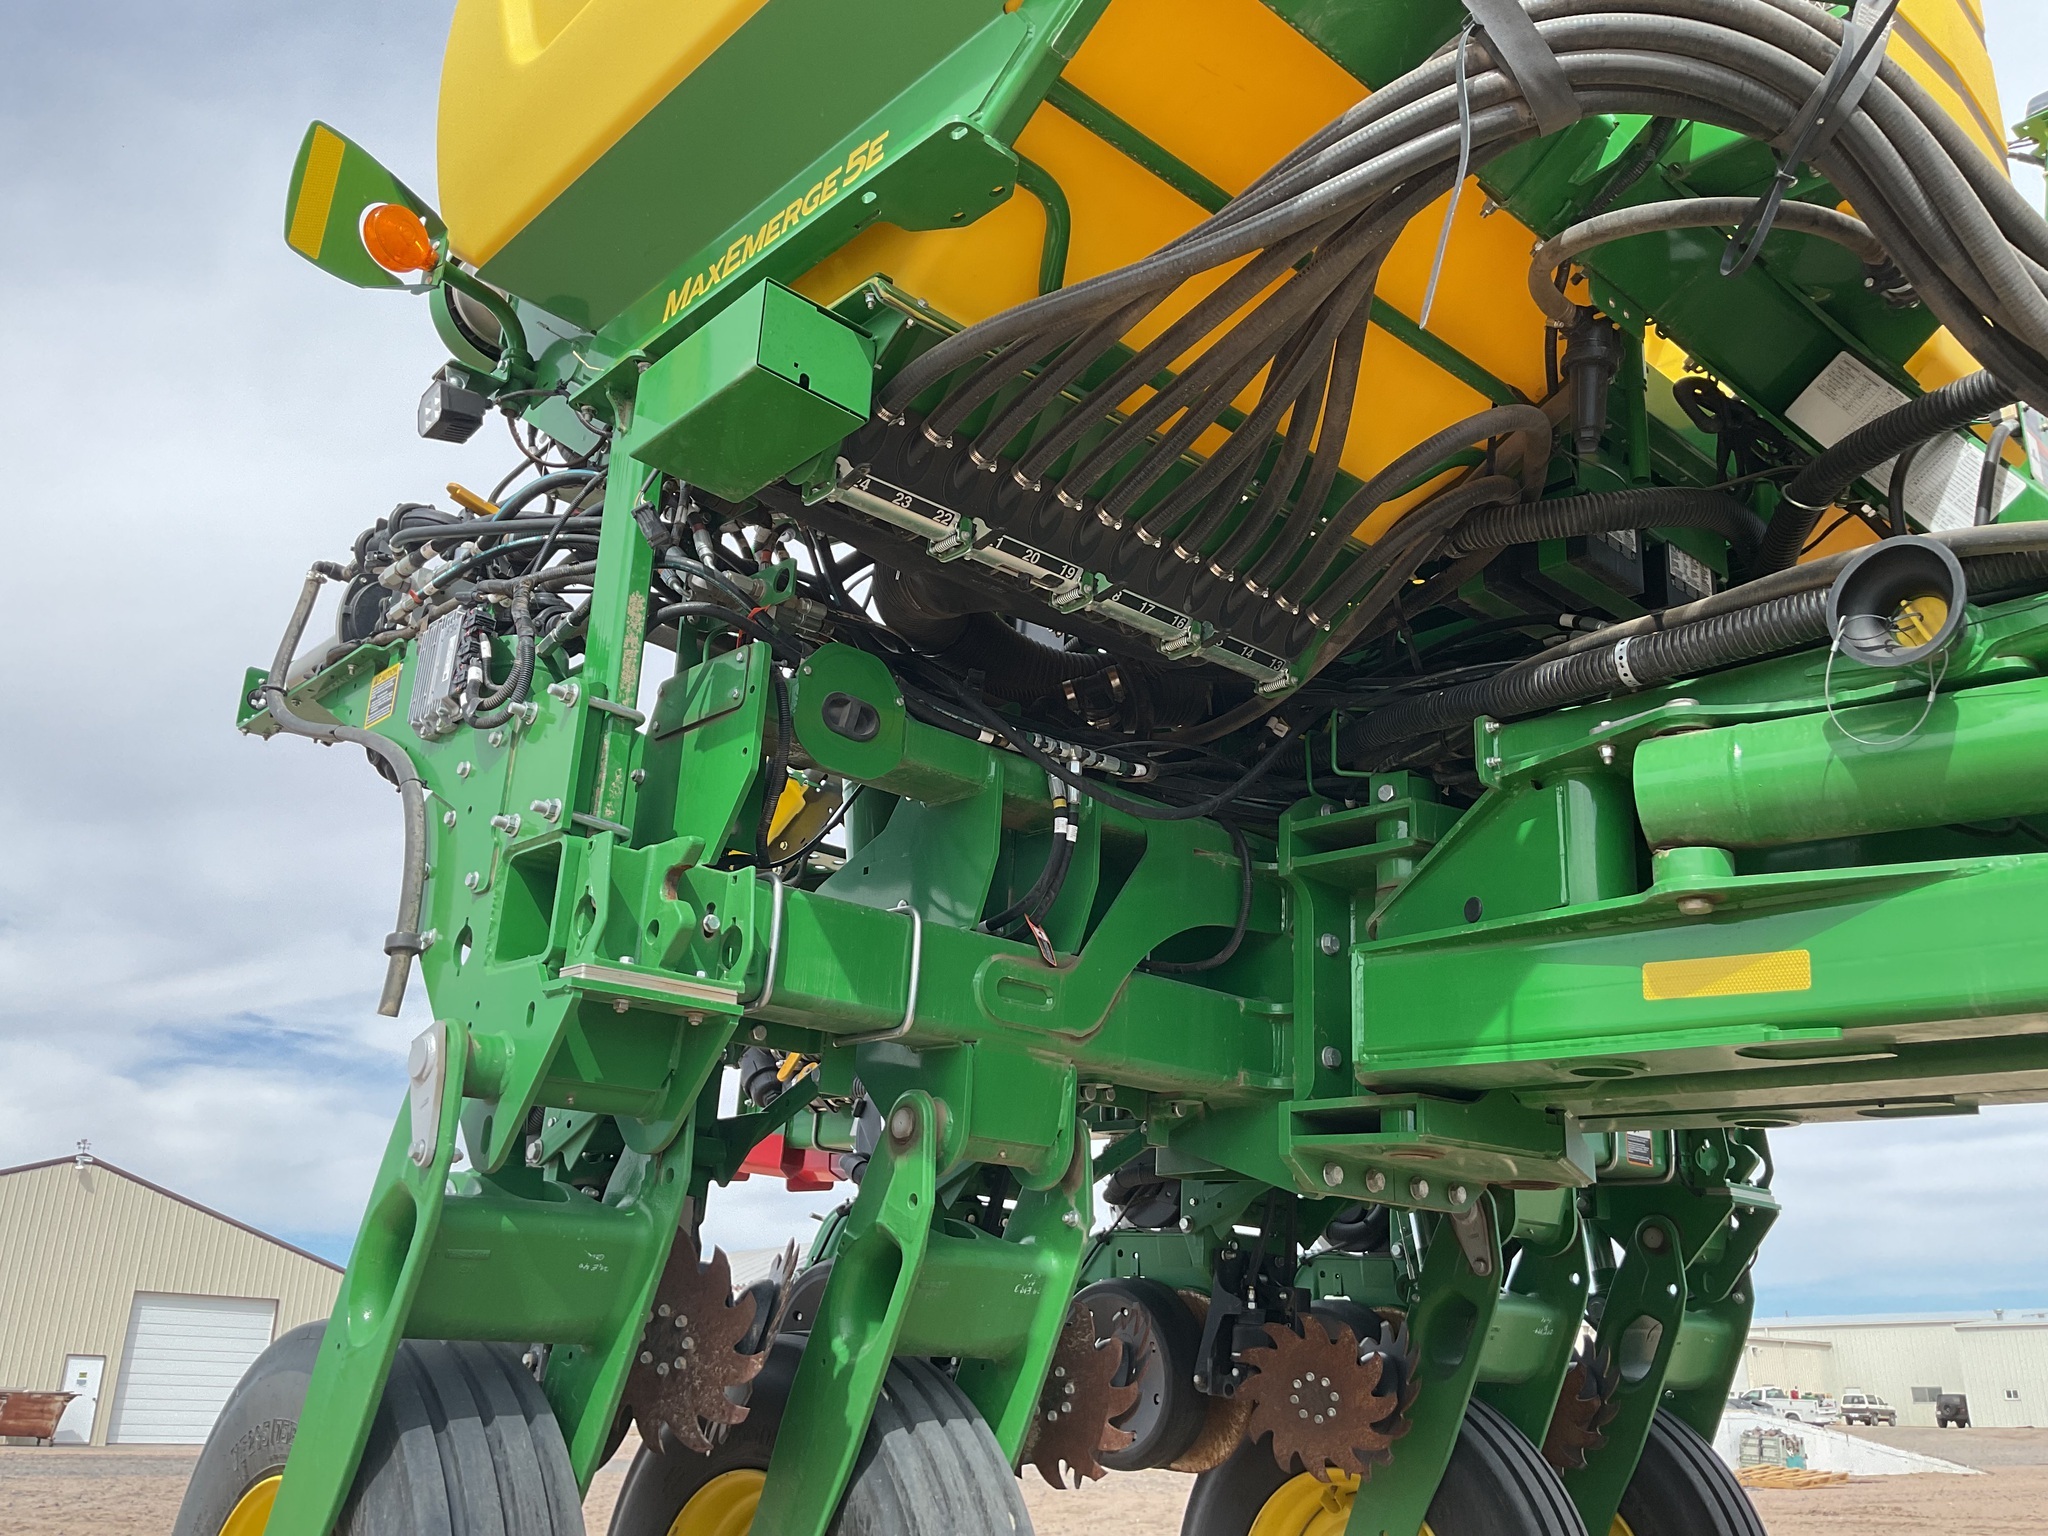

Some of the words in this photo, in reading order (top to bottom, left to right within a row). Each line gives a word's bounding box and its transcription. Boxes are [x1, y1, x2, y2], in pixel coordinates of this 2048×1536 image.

[843, 130, 889, 187] 5E
[892, 492, 912, 508] 23
[932, 509, 953, 526] 22
[990, 537, 1004, 549] 1
[1022, 549, 1040, 564] 20
[1060, 564, 1076, 579] 19
[1140, 602, 1156, 615] 17
[1171, 615, 1186, 629] 16
[1241, 646, 1255, 659] 14
[1269, 658, 1283, 671] 13
